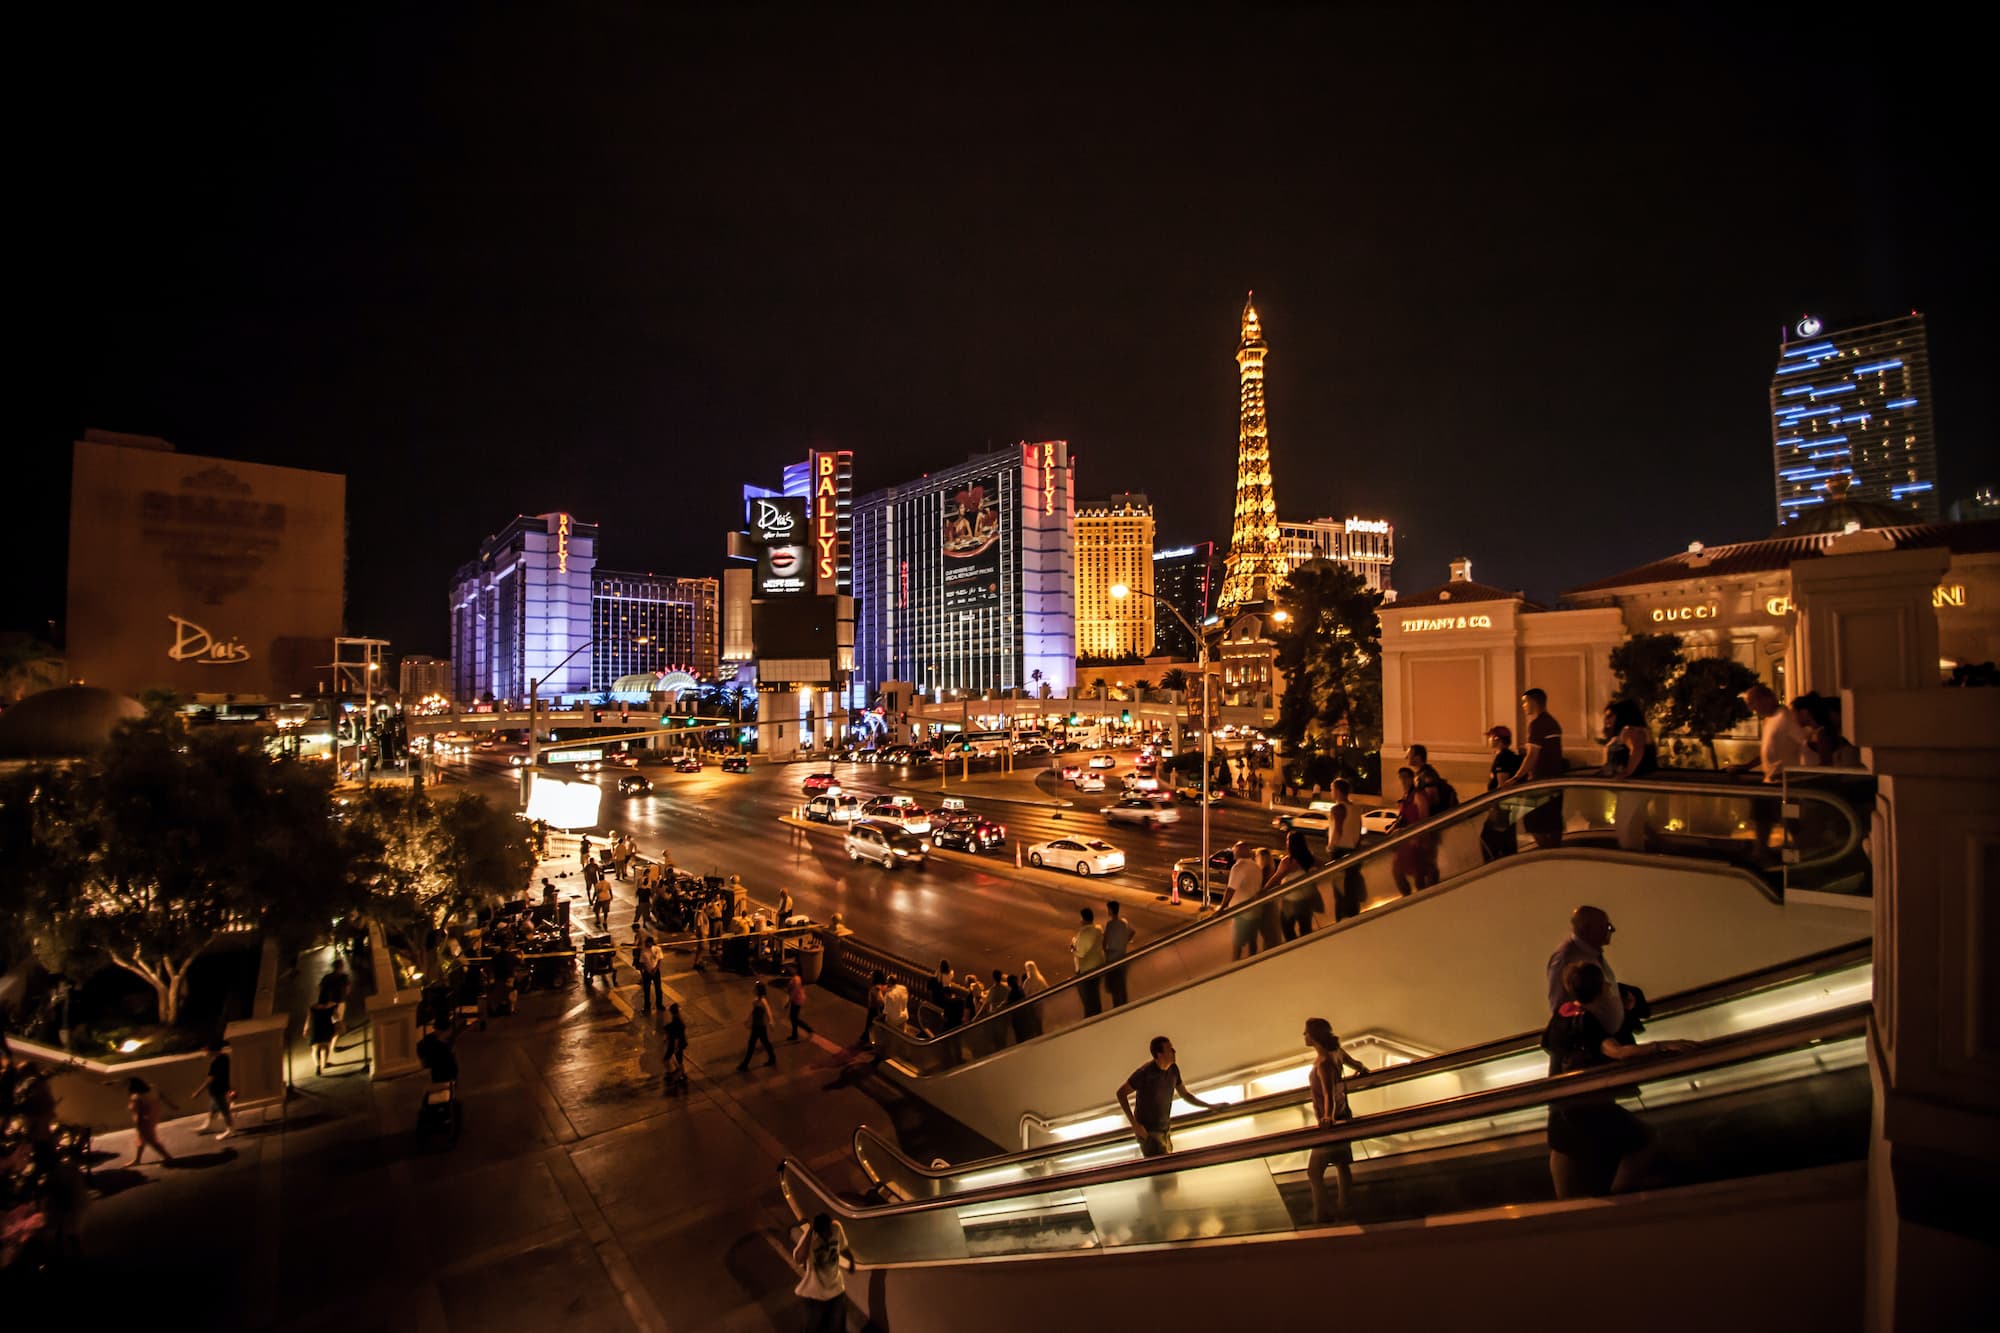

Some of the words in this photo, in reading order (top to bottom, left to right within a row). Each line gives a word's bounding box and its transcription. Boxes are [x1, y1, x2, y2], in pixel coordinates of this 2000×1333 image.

[1043, 443, 1055, 516] BALLYS
[818, 456, 836, 578] BALLYS
[1345, 515, 1388, 535] planet
[558, 513, 568, 573] BALLYS
[1401, 617, 1455, 633] TIFFANY
[1456, 616, 1467, 629] &
[1652, 605, 1717, 622] GUCCI
